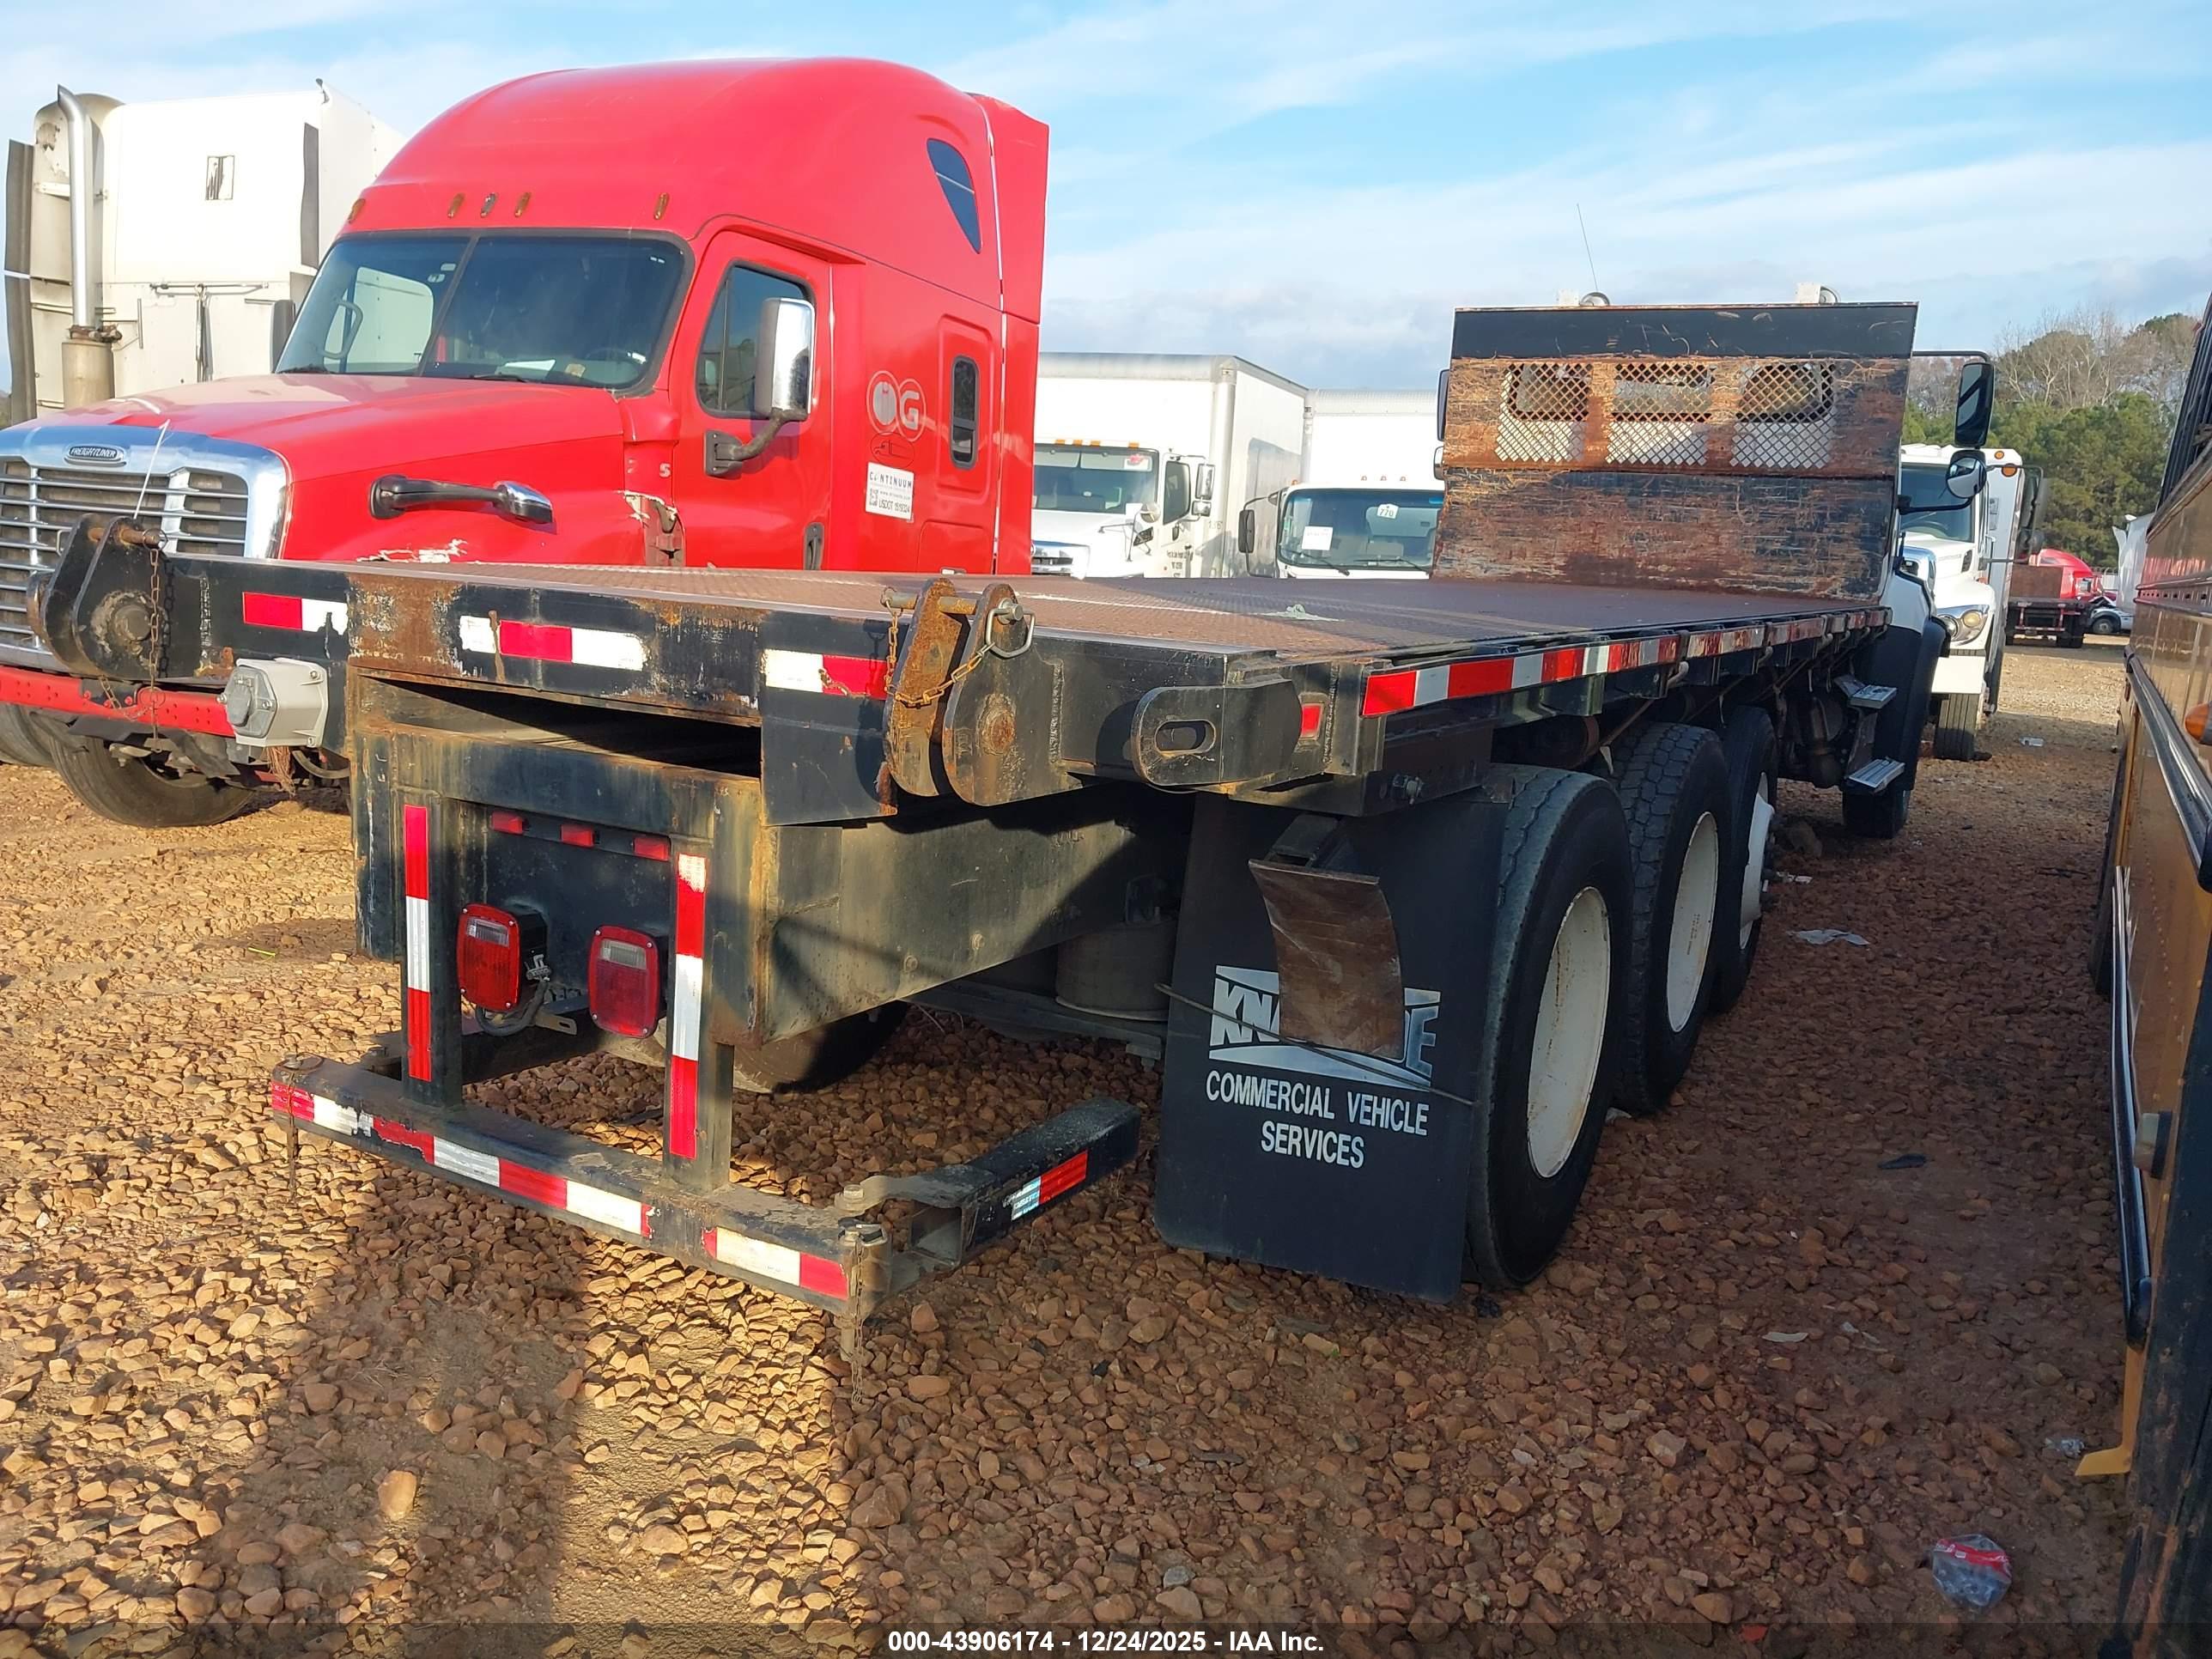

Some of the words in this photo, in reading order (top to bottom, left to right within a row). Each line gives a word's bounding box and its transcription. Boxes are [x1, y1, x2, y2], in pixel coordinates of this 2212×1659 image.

[70, 447, 116, 458] FREIGHTLINER
[1380, 508, 1395, 517] 770
[1206, 1070, 1335, 1120] COMMERCIAL
[1346, 1091, 1430, 1136] VEHICLE
[1261, 1120, 1365, 1169] SERVICES
